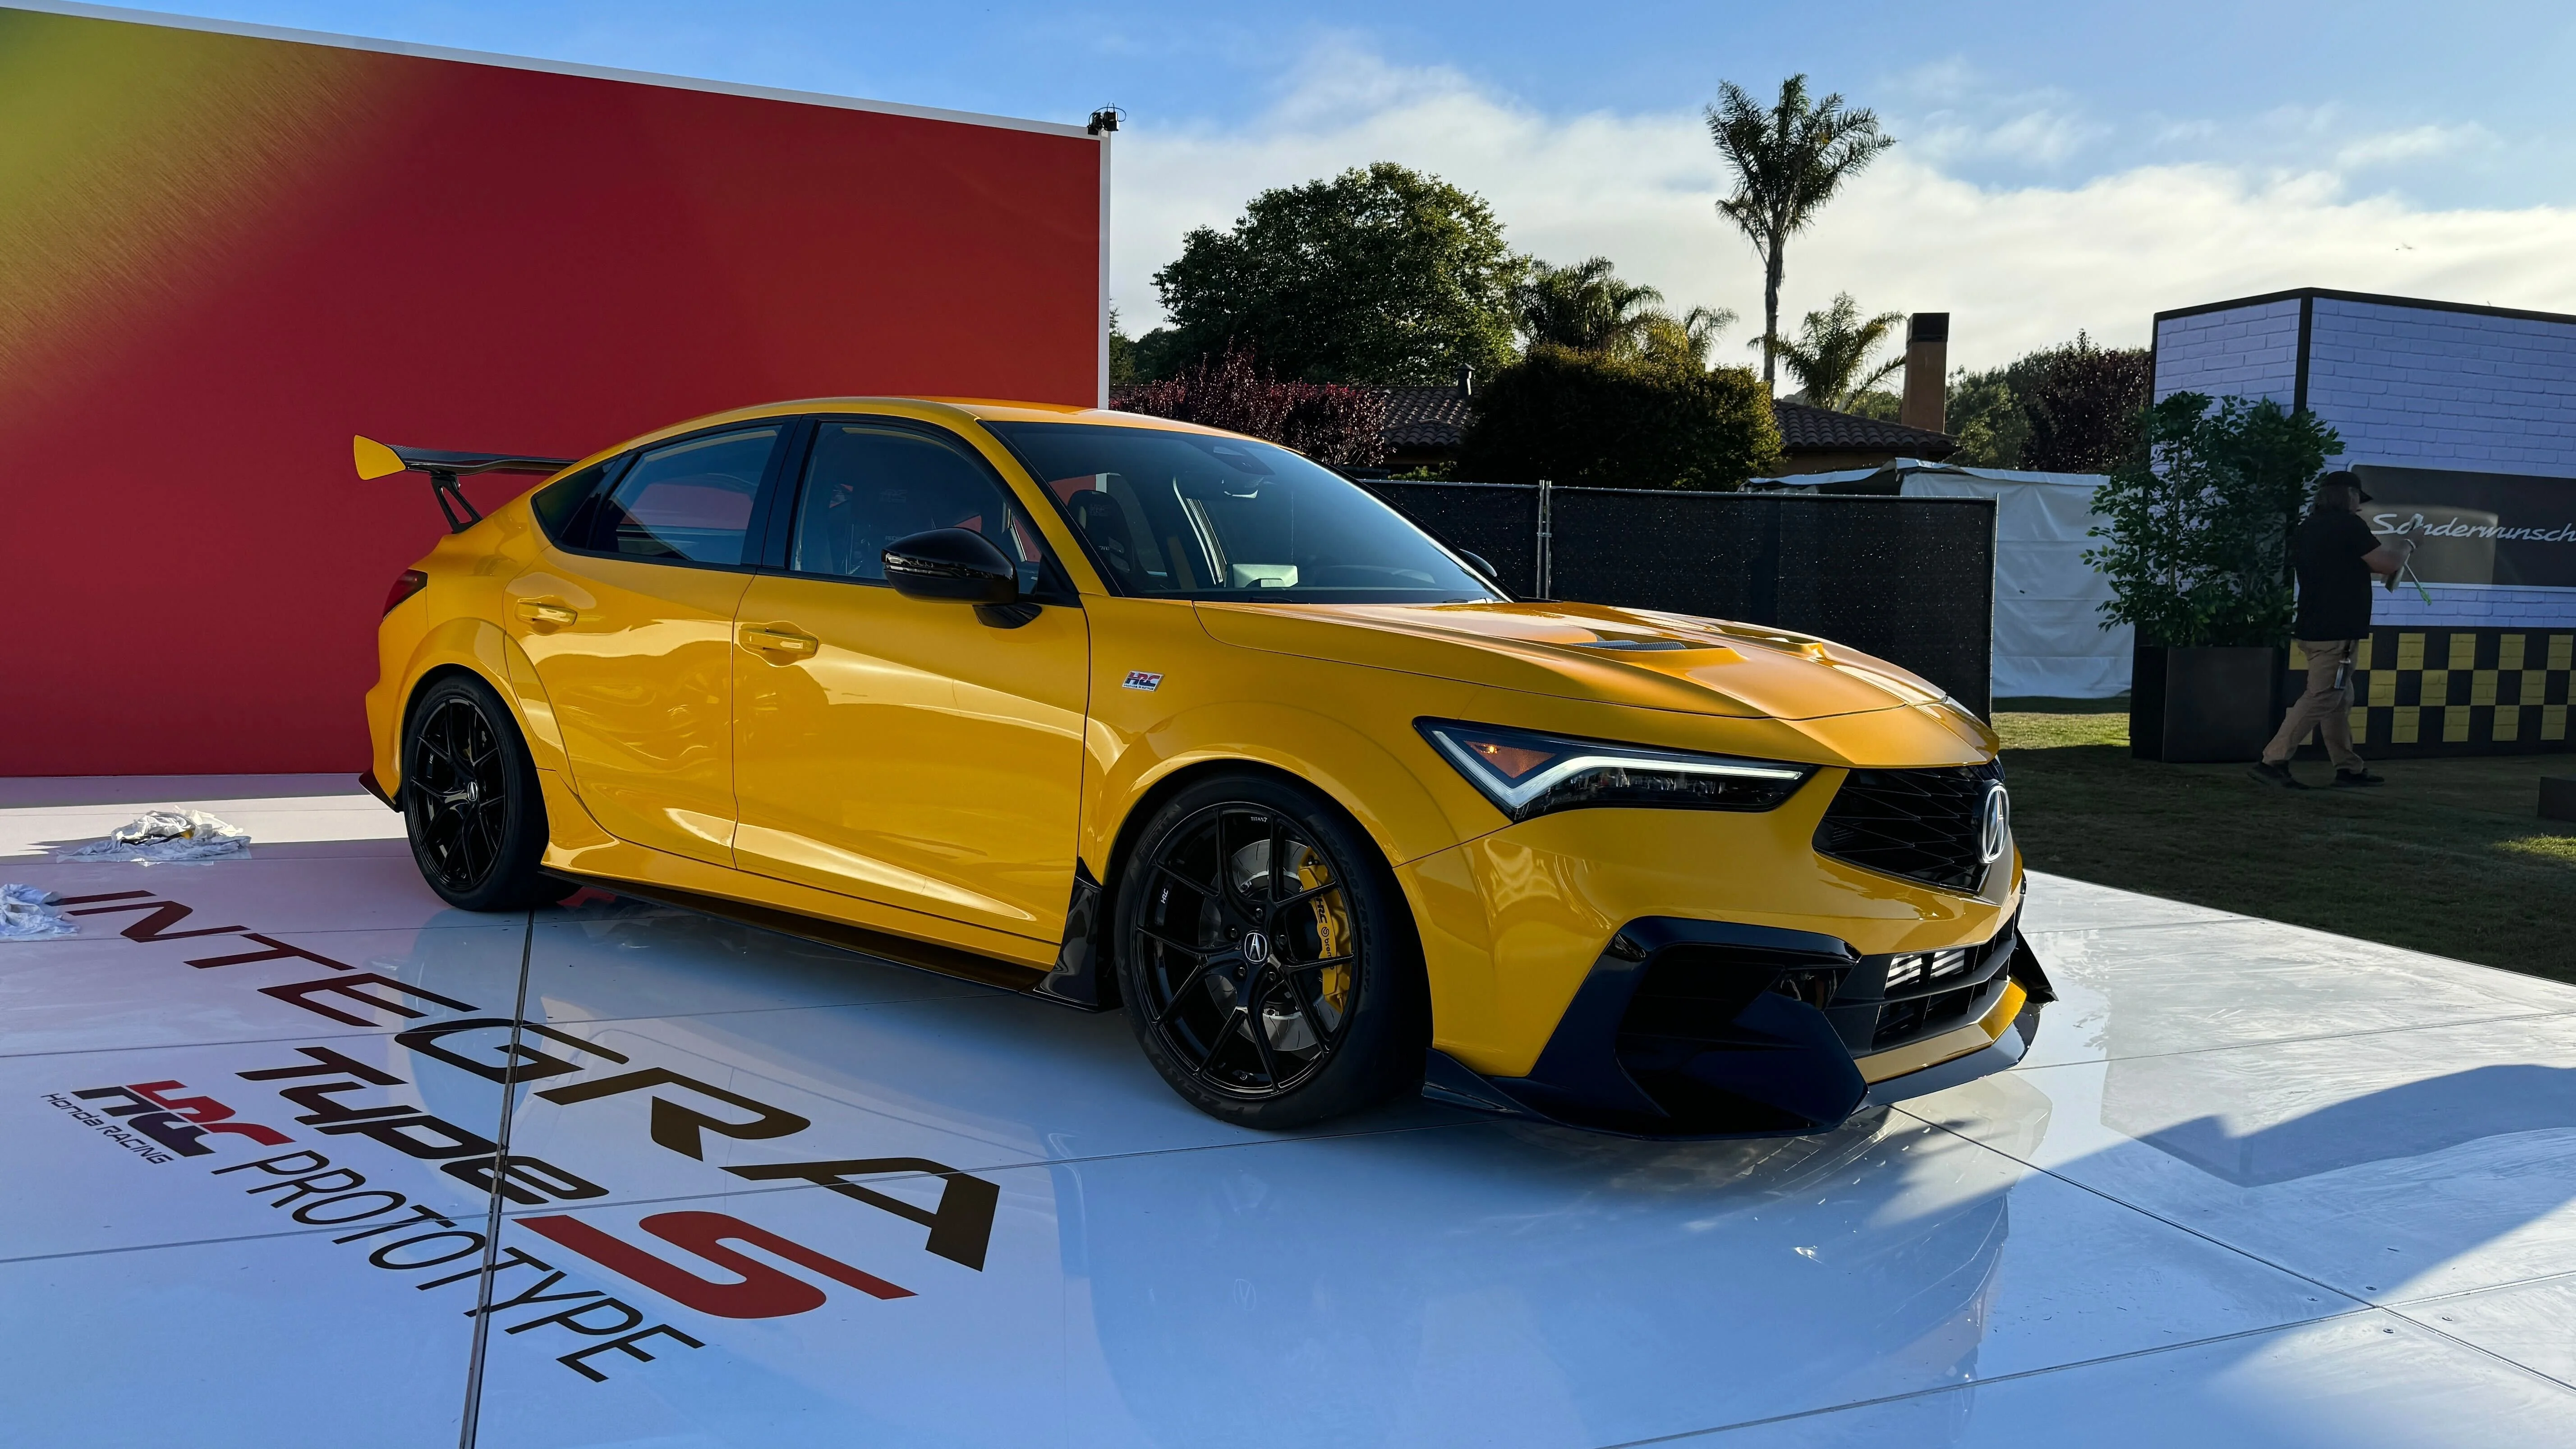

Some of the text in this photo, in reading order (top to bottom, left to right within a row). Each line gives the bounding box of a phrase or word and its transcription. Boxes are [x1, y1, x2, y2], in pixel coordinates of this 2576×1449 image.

[1160, 888, 1168, 904] HRC
[1316, 897, 1328, 924] HRC
[44, 890, 1000, 1272] INTEGRA
[70, 1080, 297, 1157] HRC
[96, 1125, 175, 1164] RACING
[211, 1150, 706, 1383] PROTOTYPE
[511, 1211, 919, 1319] S
